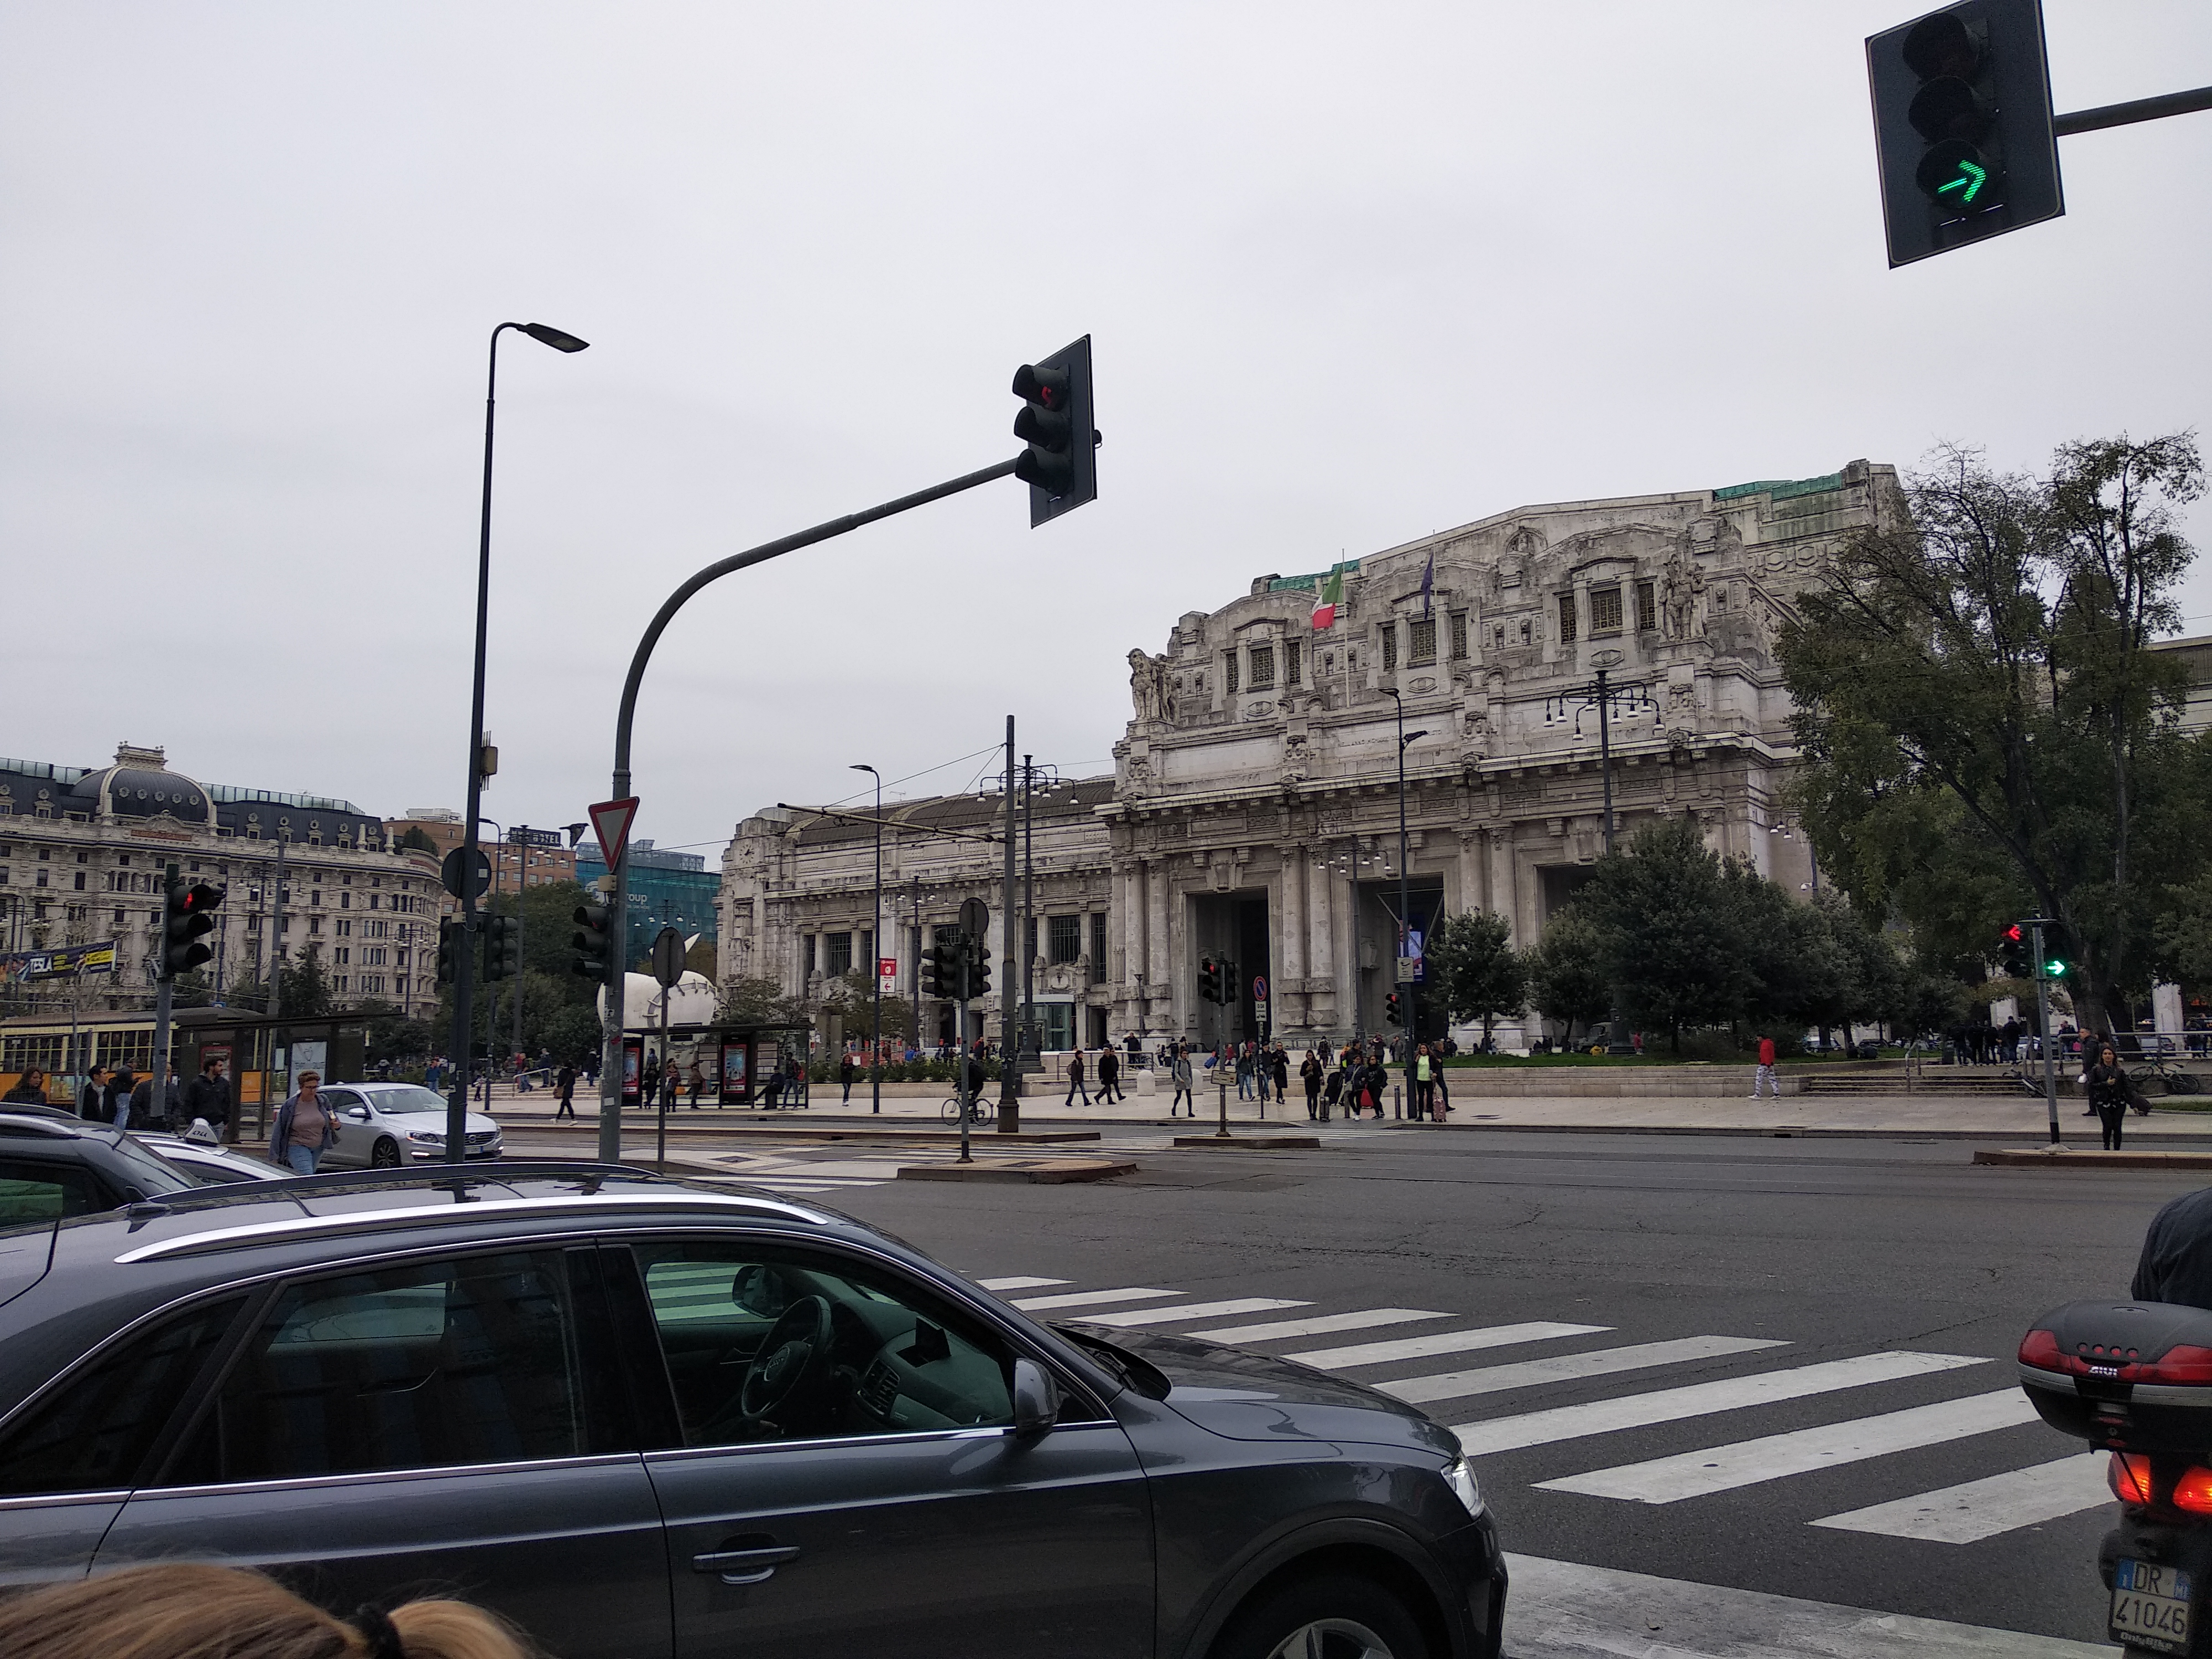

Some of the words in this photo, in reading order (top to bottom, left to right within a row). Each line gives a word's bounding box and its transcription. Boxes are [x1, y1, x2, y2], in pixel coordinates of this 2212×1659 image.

[532, 833, 560, 844] HOTEL
[30, 957, 53, 973] TESLA
[2089, 1366, 2117, 1376] GIVI
[2133, 1563, 2162, 1594] DR
[2115, 1597, 2185, 1635] 41046
